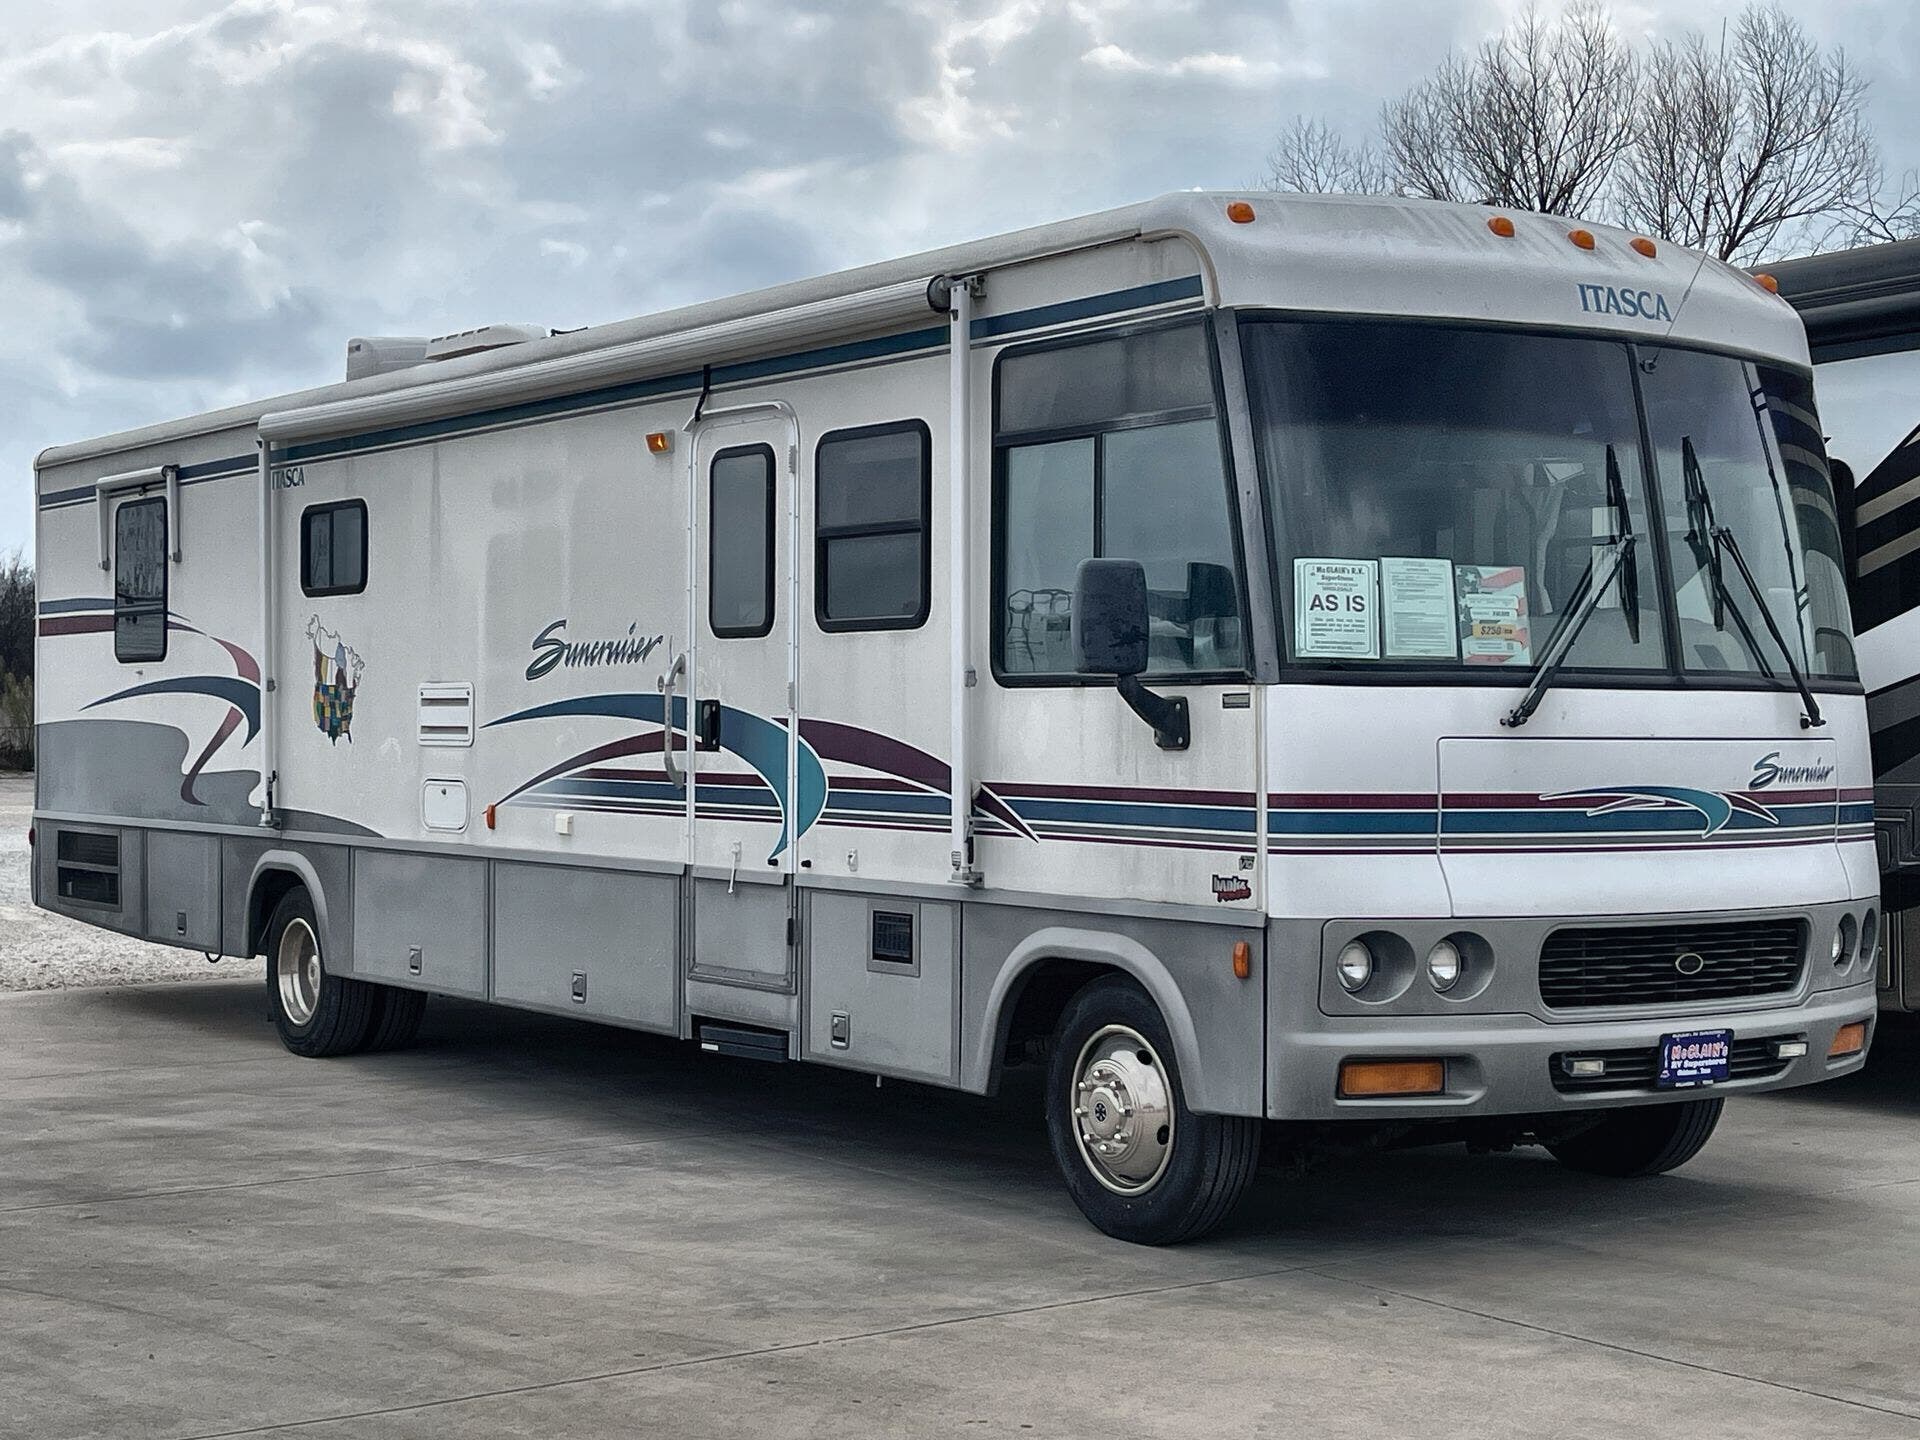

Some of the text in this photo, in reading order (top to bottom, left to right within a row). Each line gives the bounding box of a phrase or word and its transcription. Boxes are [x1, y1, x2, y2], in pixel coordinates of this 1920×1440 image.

[1577, 283, 1673, 323] ITASCA
[271, 467, 305, 490] ITASCA
[1309, 594, 1365, 613] AS IS
[525, 619, 664, 681] Suncruiser
[1670, 1060, 1683, 1070] RV
